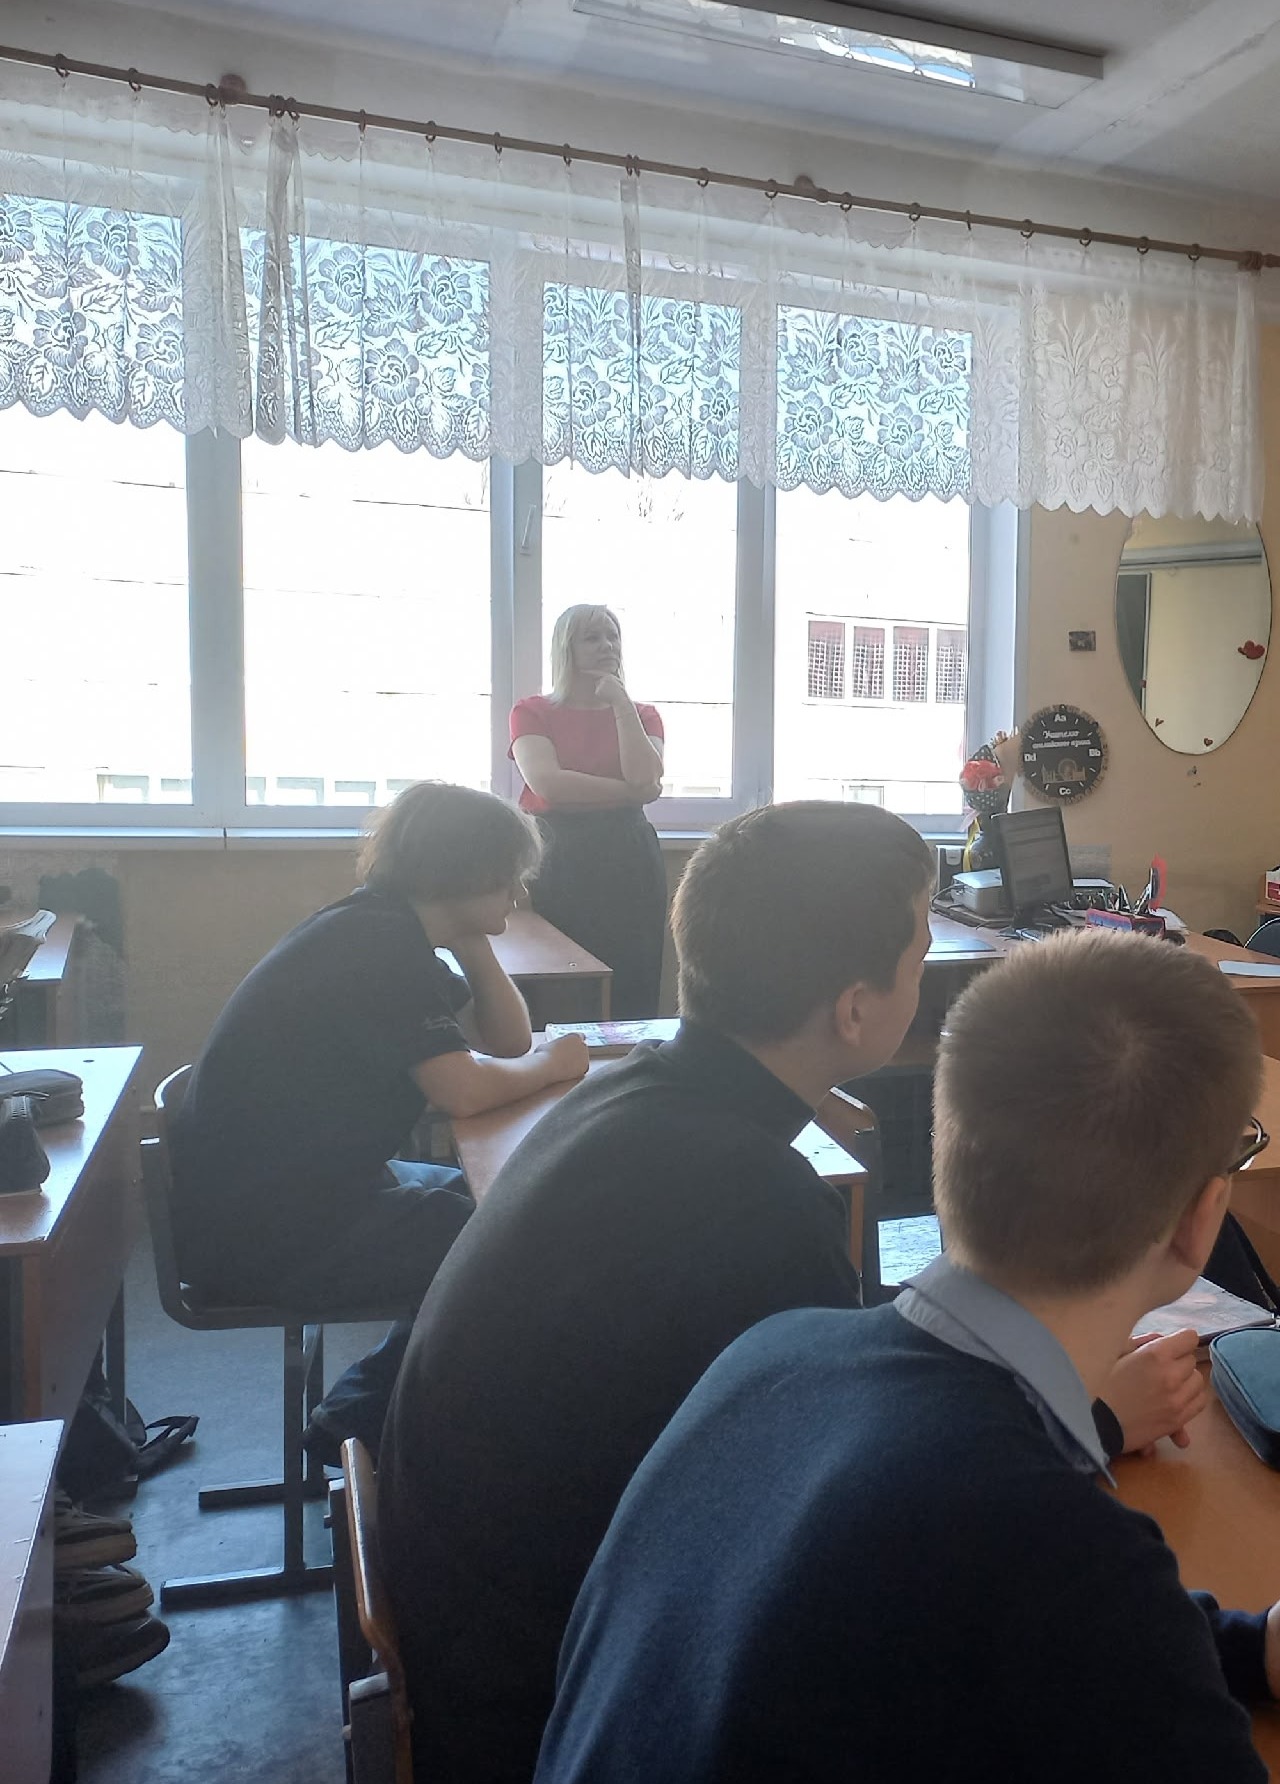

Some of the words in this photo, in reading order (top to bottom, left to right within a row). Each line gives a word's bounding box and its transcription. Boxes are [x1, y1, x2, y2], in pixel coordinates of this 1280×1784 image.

[1054, 713, 1067, 722] Aa
[1024, 752, 1037, 762] Dd
[1088, 748, 1101, 757] Bb
[1058, 787, 1072, 796] Cc
